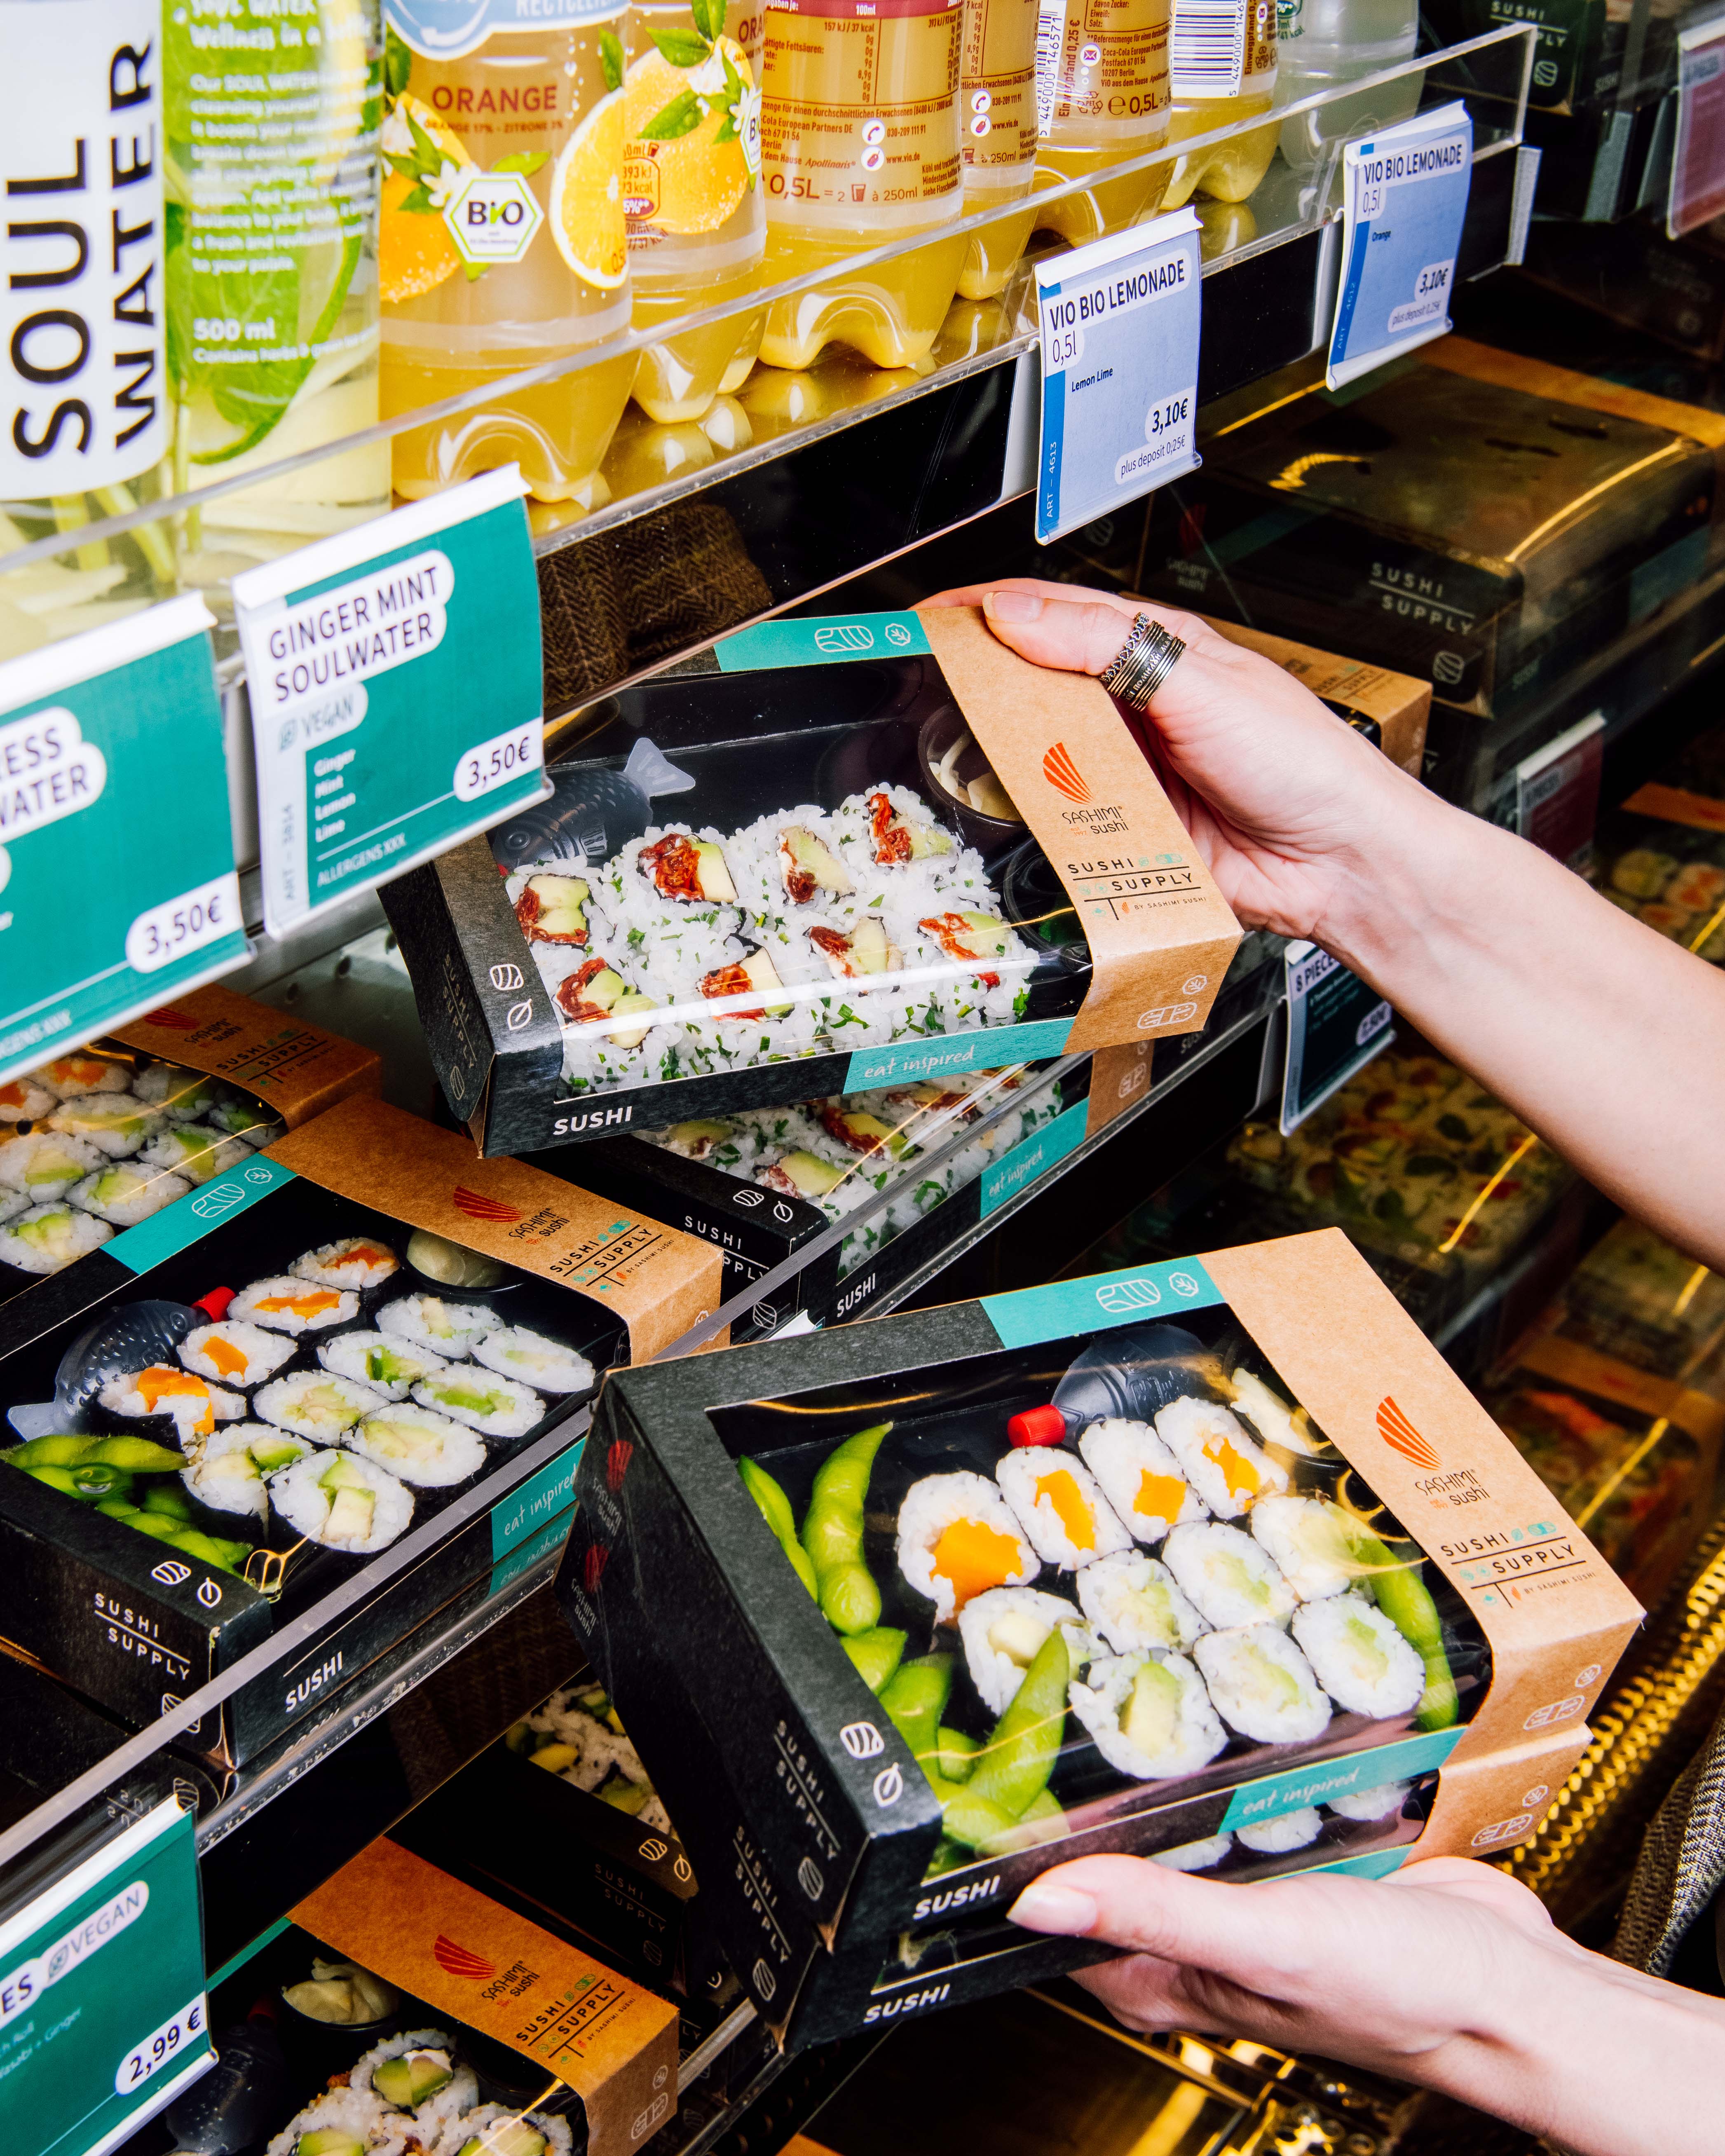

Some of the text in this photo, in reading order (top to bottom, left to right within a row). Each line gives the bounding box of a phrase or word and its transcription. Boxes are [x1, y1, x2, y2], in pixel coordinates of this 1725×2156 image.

[856, 3, 876, 16] 100ml
[971, 0, 983, 9] kcal
[1091, 9, 1109, 18] Eiweiß:
[281, 22, 302, 47] in
[307, 26, 321, 46] a
[825, 22, 874, 33] 157 kcal
[1089, 19, 1102, 28] Salz:
[786, 41, 824, 54] Fettsäuren:
[1066, 29, 1080, 52] 0,25
[1103, 45, 1151, 56] Coca-Cola European
[1245, 14, 1255, 75] Einwegpfand
[1038, 17, 1062, 120] 449000 146571
[1102, 58, 1126, 67] Postfach
[1119, 67, 1134, 76] Berlin
[1232, 35, 1242, 80] 449000
[190, 74, 221, 92] Our
[858, 69, 871, 81] 8,9g
[983, 78, 1012, 88] Erwachsenen
[1123, 78, 1133, 86] dem
[432, 85, 557, 112] ORANGE
[783, 102, 912, 119] für einen durchschnittlichen Erwachsenen
[992, 96, 1010, 106] 030-209
[1130, 93, 1158, 116] 0,5L
[778, 118, 853, 134] European Partners DE
[887, 127, 910, 137] 030-209
[992, 119, 1018, 130] www.vio.de
[762, 138, 782, 150] Berlin
[765, 151, 802, 165] dem Hause
[886, 151, 920, 164] www.vio.de
[991, 151, 1016, 163] 250ml
[923, 172, 947, 185] Mindestens
[1364, 144, 1462, 185] VIO BIO LEMONADE
[634, 180, 653, 194] kcal
[769, 173, 917, 201] 0,5L 250ml
[110, 37, 156, 449] WATER
[1372, 230, 1391, 242] Orange
[1050, 259, 1185, 330] VIO BIO LEMONADE
[1420, 268, 1448, 296] 3,10€
[6, 139, 92, 458] SOUL
[194, 317, 275, 341] 500 ml
[1406, 308, 1425, 322] deposit
[193, 347, 259, 363] Contains
[1052, 330, 1077, 366] 0,5l
[1071, 366, 1113, 392] Lemon Lime
[1151, 398, 1188, 436] 3,10€
[1048, 441, 1058, 474] 4613
[1121, 434, 1186, 479] plus deposit 0,25€
[1371, 562, 1445, 598] SUSHI
[270, 565, 439, 659] GINGER MINT
[1381, 593, 1474, 636] SUPPLY
[275, 611, 432, 702] SOULWATER
[301, 692, 355, 738] VEGAN
[313, 748, 357, 778] Ginger
[469, 736, 531, 790] 3,50€
[314, 774, 345, 799] Mint
[314, 792, 356, 821] Lemon
[316, 817, 346, 844] Lime
[1090, 819, 1129, 834] sushi
[317, 843, 383, 887] ALLERGENS
[1068, 858, 1134, 874] SUSHI
[1111, 872, 1193, 891] SUPPLY
[1148, 896, 1207, 908] SASHIMI SUSHI
[146, 895, 223, 956] 3,50€
[212, 1024, 244, 1042] sushi
[216, 1044, 267, 1070] SUSHI
[258, 1035, 317, 1067] SUPPLY
[864, 1044, 975, 1079] eat inspired
[553, 1106, 633, 1136] SUSHI
[989, 1144, 1044, 1198] eat inspired
[539, 1217, 570, 1237] sushi
[684, 1215, 742, 1250] SUSHI
[549, 1240, 600, 1273] SUSHI
[593, 1228, 653, 1268] SUPPLY
[635, 1240, 675, 1268] SASHIMI SUSHI
[837, 1273, 876, 1317] SUSHI
[1449, 1484, 1491, 1506] sushi
[504, 1504, 525, 1536] eat
[1441, 1533, 1510, 1556] SUSHI
[1492, 1544, 1575, 1574] SUPPLY
[1537, 1572, 1597, 1591] SASHIMI SUSHI
[95, 1592, 160, 1638] SUSHI
[108, 1628, 190, 1681] SUPPLY
[285, 1651, 343, 1713] SUSHI
[776, 1719, 825, 1803] SUSHI
[1242, 1767, 1361, 1814] eat inspired
[595, 1863, 644, 1901] SUSHI
[604, 1888, 666, 1933] SUPPLY
[913, 1875, 1001, 1920] SUSHI
[70, 1889, 141, 1956] VEGAN
[510, 1971, 540, 1997] sushi
[558, 1984, 616, 2035] SUPPLY
[595, 1997, 636, 2033] SASHIMI SUSHI
[863, 1984, 950, 2025] SUSHI
[516, 2000, 565, 2041] SUSHI
[129, 2006, 201, 2083] 2,99 €
